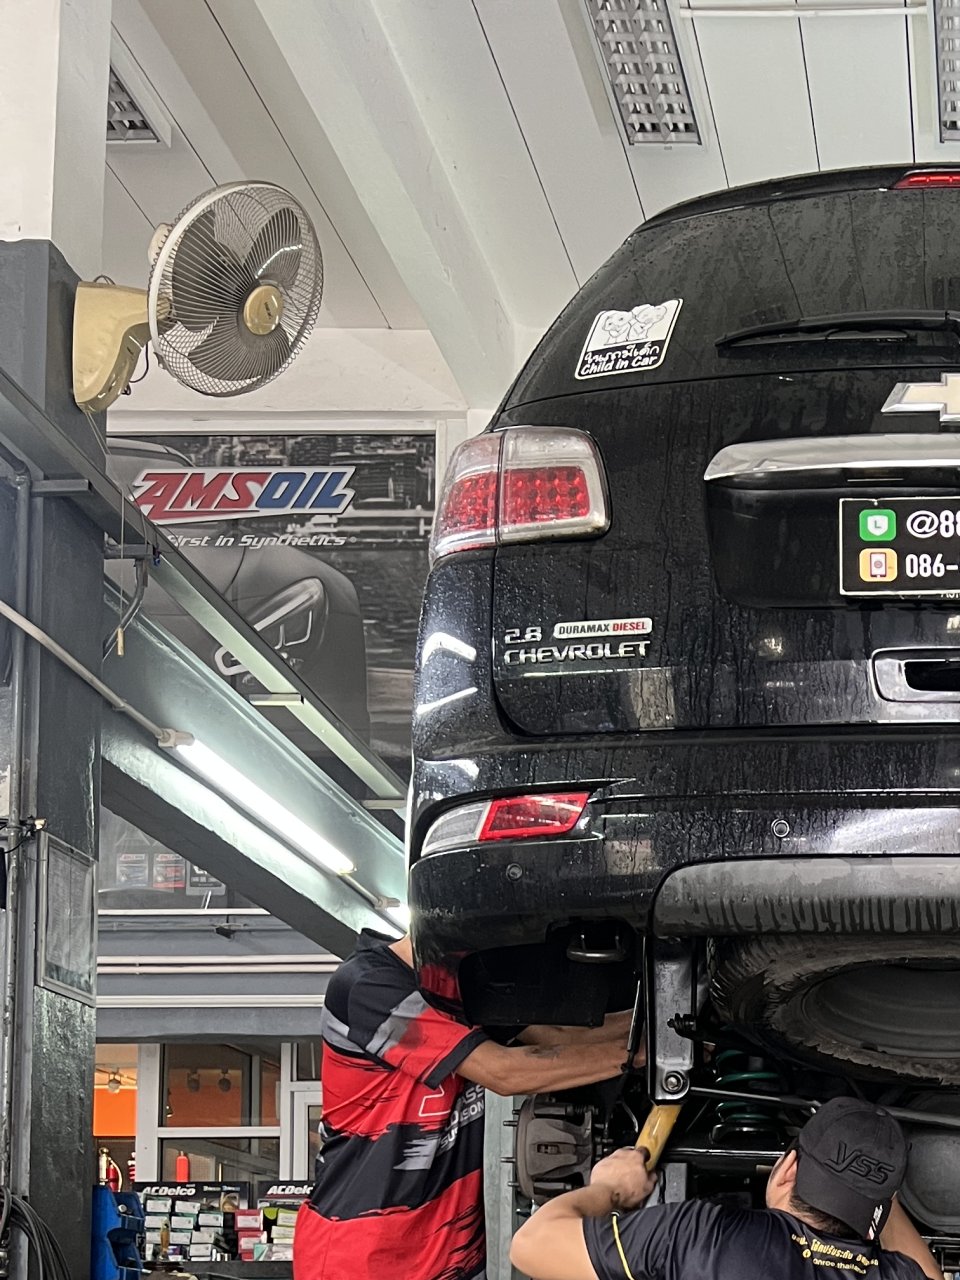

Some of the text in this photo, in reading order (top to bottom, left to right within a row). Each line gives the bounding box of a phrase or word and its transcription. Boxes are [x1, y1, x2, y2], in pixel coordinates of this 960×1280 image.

[580, 355, 657, 375] Child in Car
[133, 470, 350, 521] AMSOIL
[214, 534, 235, 547] in
[238, 533, 347, 550] Synthetics
[504, 626, 543, 645] 2.8
[558, 621, 647, 635] DURAMAX DIESEL
[503, 640, 650, 666] CHEVROLET
[142, 1186, 196, 1196] ACDelco
[266, 1185, 314, 1195] ACDelc
